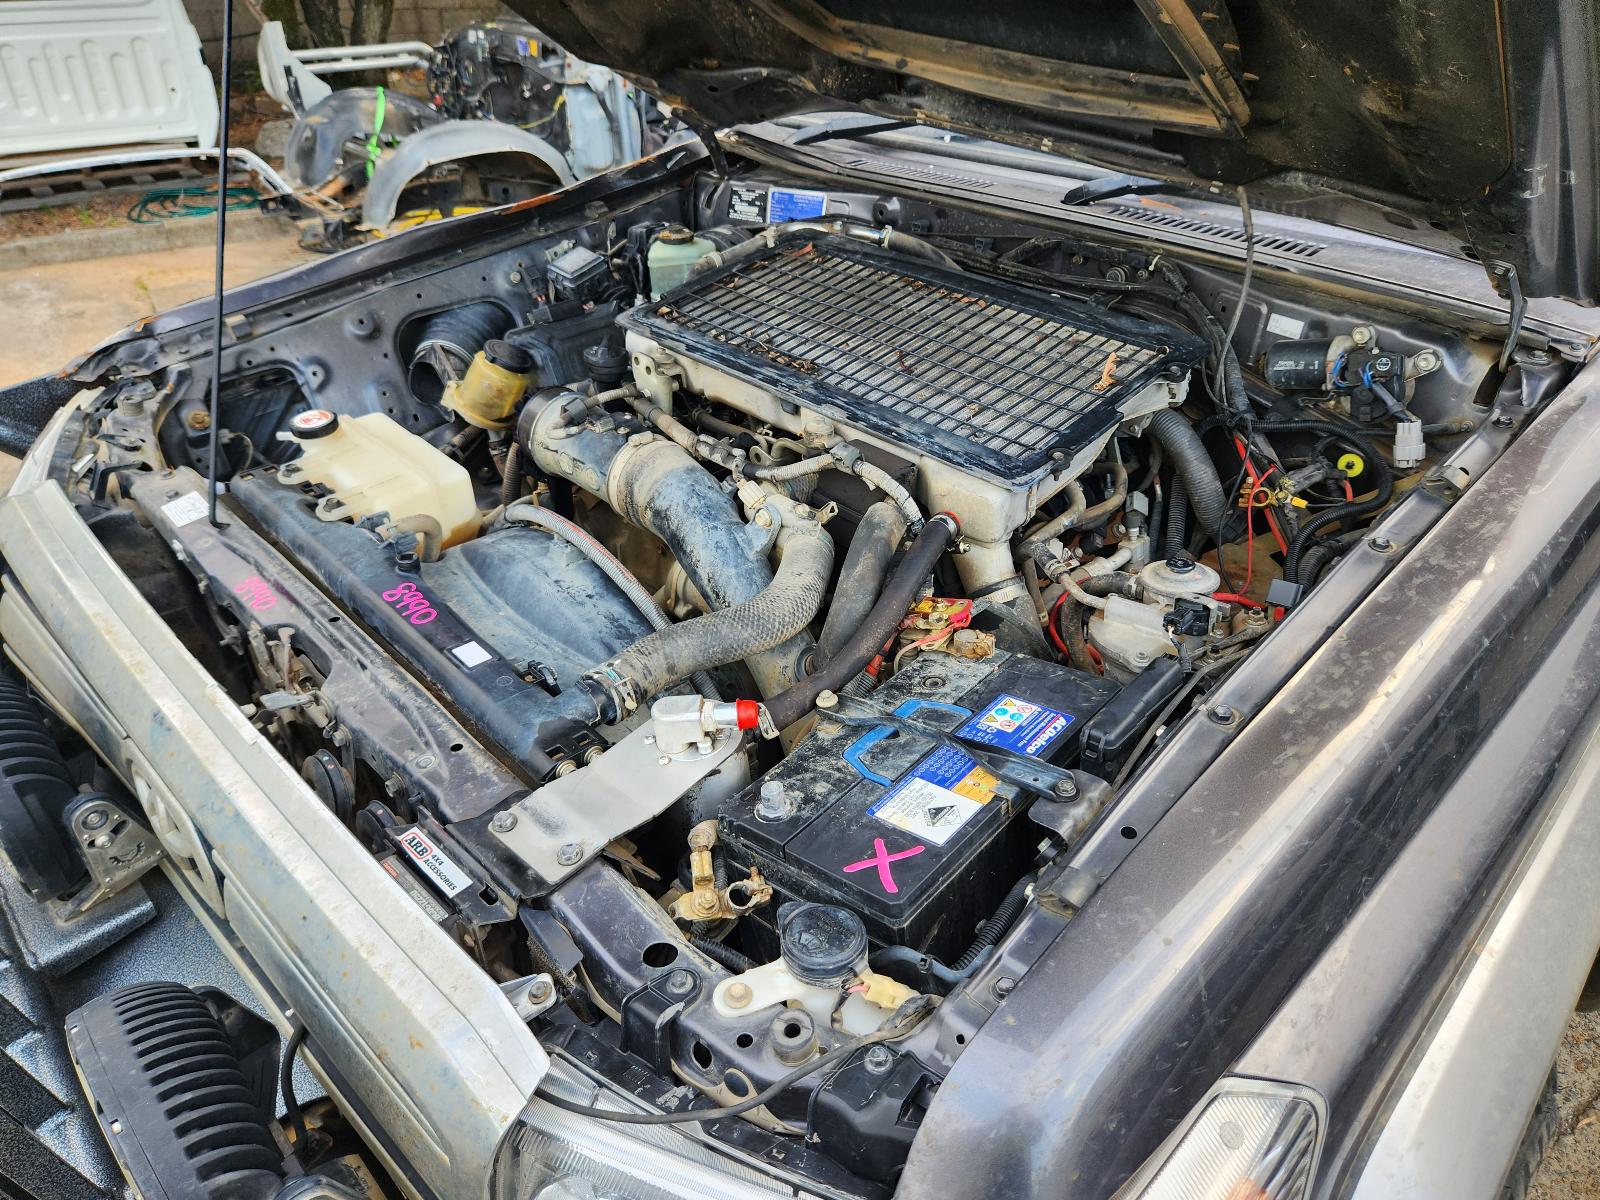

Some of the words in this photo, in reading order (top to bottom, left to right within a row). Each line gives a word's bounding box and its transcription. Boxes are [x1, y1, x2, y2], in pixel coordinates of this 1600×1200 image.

[382, 582, 437, 624] 8990
[1026, 716, 1067, 753] ACDelco
[404, 836, 429, 857] ARB
[423, 859, 458, 891] ACCESSORIES
